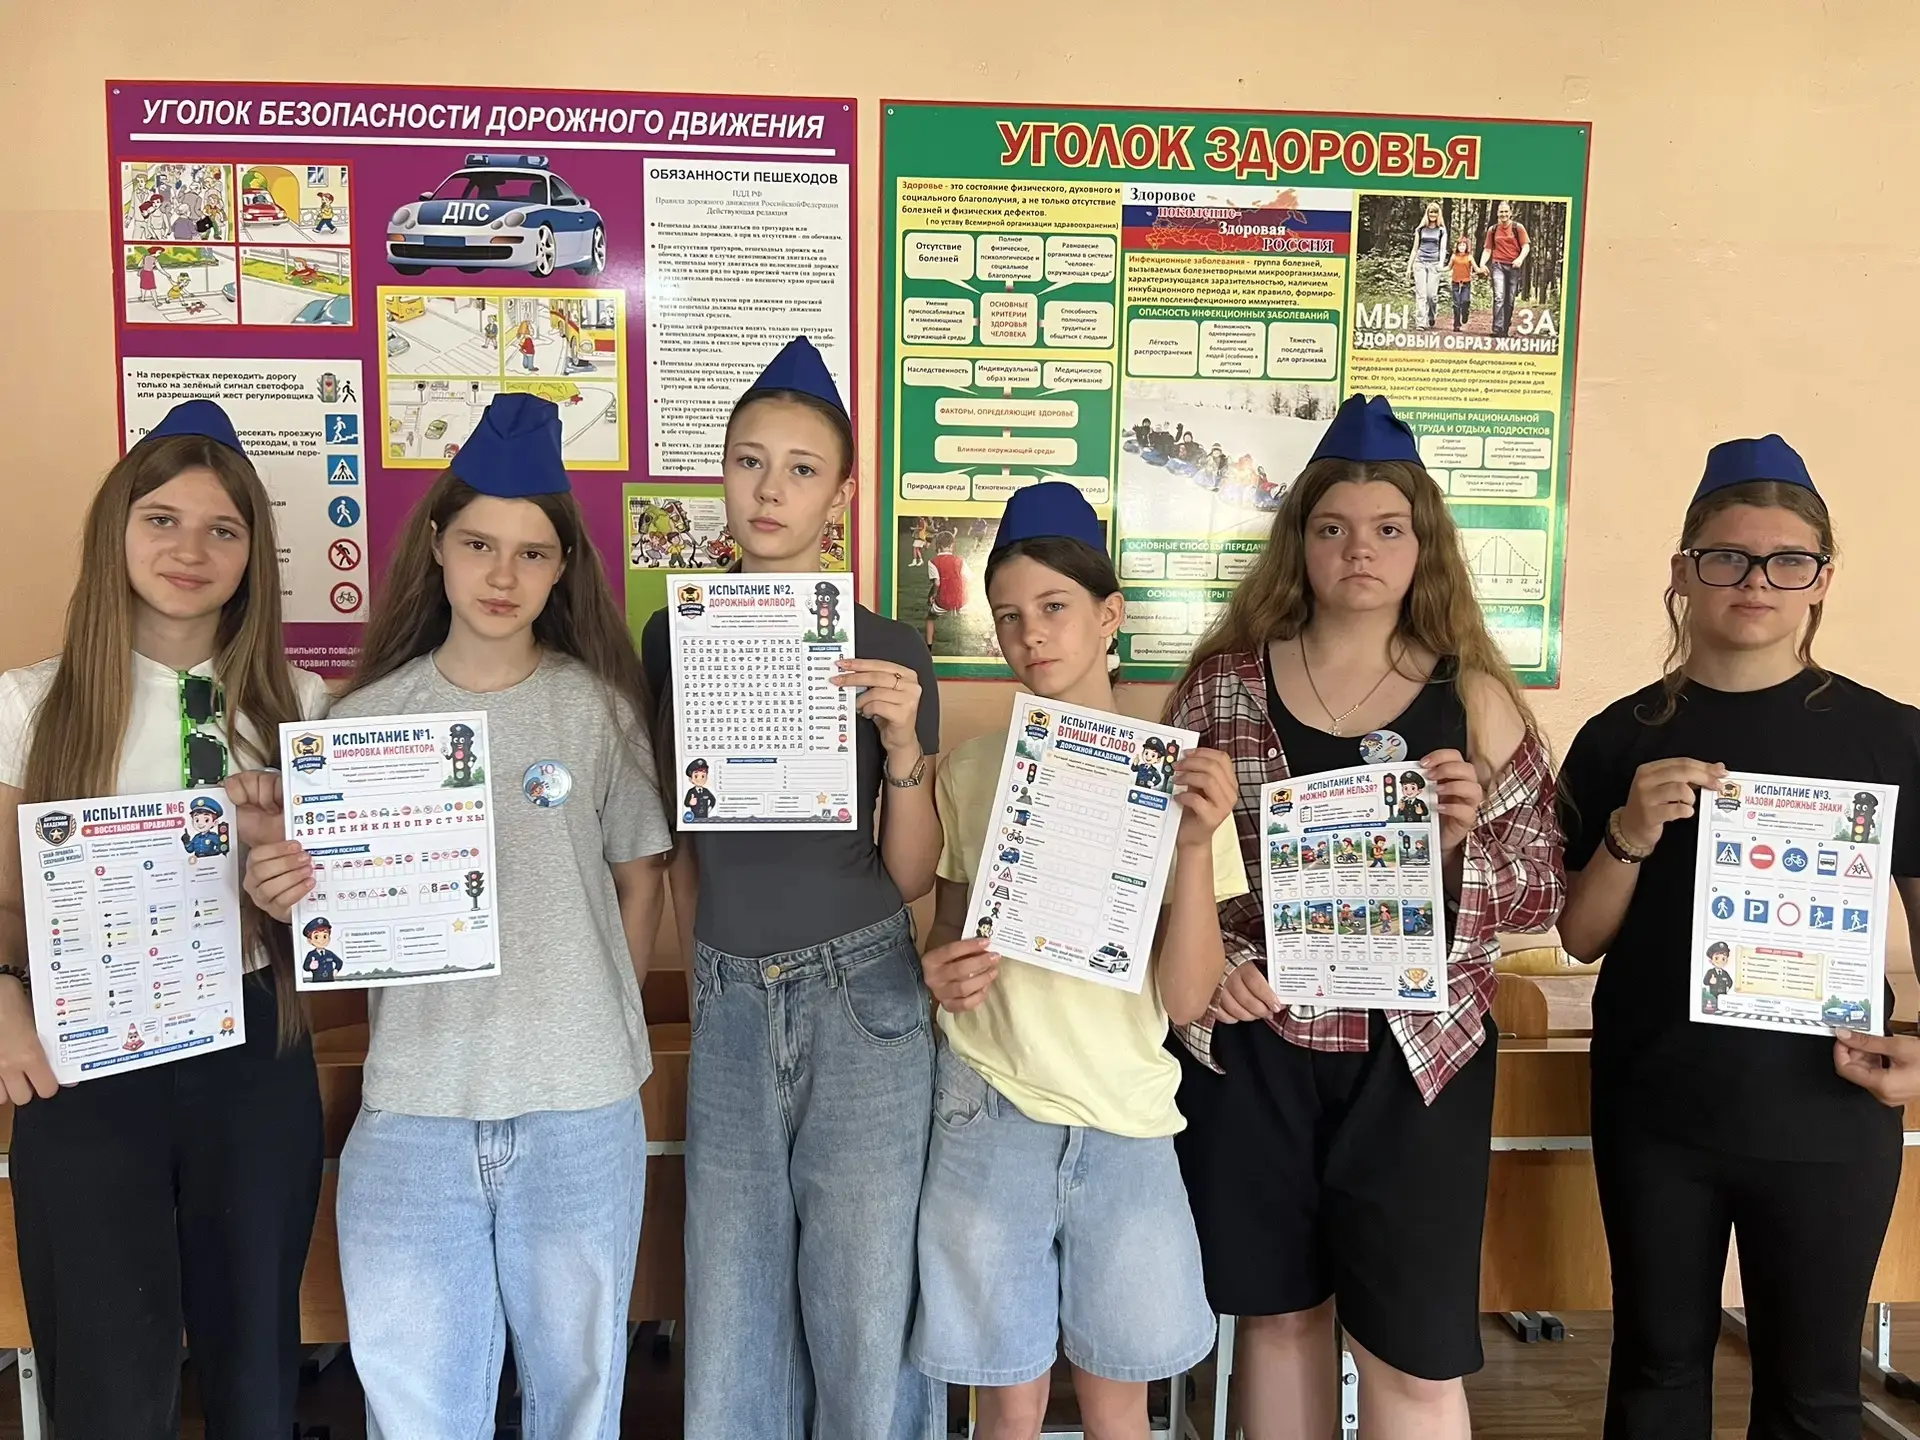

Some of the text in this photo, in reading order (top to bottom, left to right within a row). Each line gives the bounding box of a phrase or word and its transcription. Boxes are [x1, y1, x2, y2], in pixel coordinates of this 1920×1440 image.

[142, 98, 825, 140] УГОЛОК БЕЗОПАСНОСТИ ДОРОЖНОГО ДВИЖЕНИЯ
[996, 121, 1482, 180] УГОЛОК ЗДОРОВЬЯ
[650, 169, 838, 185] ОБЯЗАННОСТИ ПЕШЕХОДОВ
[902, 181, 1113, 194] Здоровье это состояние физического, духовного
[902, 194, 956, 203] социального
[958, 195, 1020, 205] благополучия,
[1071, 198, 1116, 207] отсутствие
[1130, 187, 1196, 204] Здоровое
[655, 197, 685, 205] Правила
[687, 199, 725, 207] дорожного
[442, 202, 490, 223] ДПС
[706, 208, 788, 217] Действующая редакция
[902, 205, 1047, 218] болезней физических дефектов.
[941, 219, 963, 227] уставу
[965, 218, 1005, 227] Всемирной
[1006, 220, 1052, 229] организации
[1053, 221, 1119, 230] здравоохранения)
[1218, 222, 1286, 237] Здоровая
[916, 242, 962, 252] Отсутствие
[1262, 238, 1334, 253] РОССИЯ
[918, 254, 959, 263] болезней
[1129, 256, 1323, 268] Инфекционные заболевания группа болезней,
[1183, 267, 1257, 277] болезнетворными
[1258, 269, 1341, 279] микроорганизмами,
[1128, 277, 1209, 285] характеризующаяся
[1211, 278, 1287, 287] заразительностью,
[1127, 286, 1195, 294] инкубационного
[1196, 288, 1231, 297] периода
[1257, 290, 1294, 298] правило,
[1295, 290, 1336, 300] формиро-
[989, 301, 1028, 309] ОСНОВНЫЕ
[1159, 297, 1246, 307] послеинфекционного
[1248, 299, 1300, 307] иммунитета.
[1139, 308, 1330, 320] ОПАСНОСТЬ ИНФЕКЦИОННЫХ ЗАБОЛЕВАНИЙ
[1355, 302, 1556, 335] МЫ ЗА
[990, 321, 1027, 329] ЗДОРОВЬЯ
[1148, 339, 1179, 347] Лёгкость
[1354, 332, 1557, 353] ЗДОРОВЫЙ ОБРАЗ ЖИЗНИ!
[1134, 349, 1192, 357] распространения
[1281, 346, 1324, 354] последствий
[1469, 358, 1517, 366] бодрствования
[907, 366, 969, 375] Наследственность
[978, 365, 1039, 373] Индивидуальный
[1055, 366, 1102, 375] Медицинское
[150, 372, 210, 381] перекрёстках
[212, 372, 264, 381] переходить
[266, 373, 297, 382] дорогу
[986, 375, 1007, 383] образ
[1053, 376, 1103, 384] обслуживание
[137, 381, 168, 389] только
[183, 381, 222, 389] зелёный
[224, 382, 254, 390] сигнал
[256, 383, 304, 392] светофора
[156, 392, 221, 400] разрешающий
[245, 393, 314, 401] регулировщика
[939, 408, 1074, 417] ФАКТОРЫ, ОПРЕДЕЛЯЮЩИЕ ЗДОРОВЬЕ
[1416, 411, 1467, 422] ПРИНЦИПЫ
[1468, 411, 1539, 423] РАЦИОНАЛЬНОЙ
[237, 430, 323, 438] ресекать проезжую
[1418, 424, 1550, 436] ТРУДА И ОТДЫХА ПОДРОСТКОВ
[987, 447, 1033, 455] окружающей
[1128, 541, 1178, 550] ОСНОВНЫЕ
[1180, 542, 1223, 551] СПОСОБЫ
[709, 584, 794, 595] ИСПЫТАНИЕ №2.
[709, 597, 795, 608] ДОРОЖНЫЙ ФИЛВОРД
[1500, 606, 1525, 614] ТРУДА
[284, 647, 327, 655] авильного
[300, 660, 329, 668] правил
[1060, 715, 1134, 740] ИСПЫТАНИЕ №5
[332, 728, 434, 746] ИСПЫТАНИЕ №1.
[1057, 726, 1136, 753] ВПИШИ СЛОВО
[333, 744, 435, 759] ШИФРОВКА ИНСПЕКТОРА
[1060, 741, 1126, 763] ДОРОЖНОЙ АКАДЕМИИ
[1307, 775, 1372, 791] ИСПЫТАНИЕ №4.
[1300, 783, 1378, 802] МОЖНО ИЛИ НЕЛЬЗЯ?
[1754, 784, 1832, 800] ИСПЫТАНИЕ №3.
[1744, 796, 1843, 813] НАЗОВИ ДОРОЖНЫЕ ЗНАКИ
[82, 801, 185, 822] ИСПЫТАНИЕ №6
[94, 820, 176, 834] ВОССТАНОВИ ПРАВИЛО
[1750, 902, 1764, 920] P
